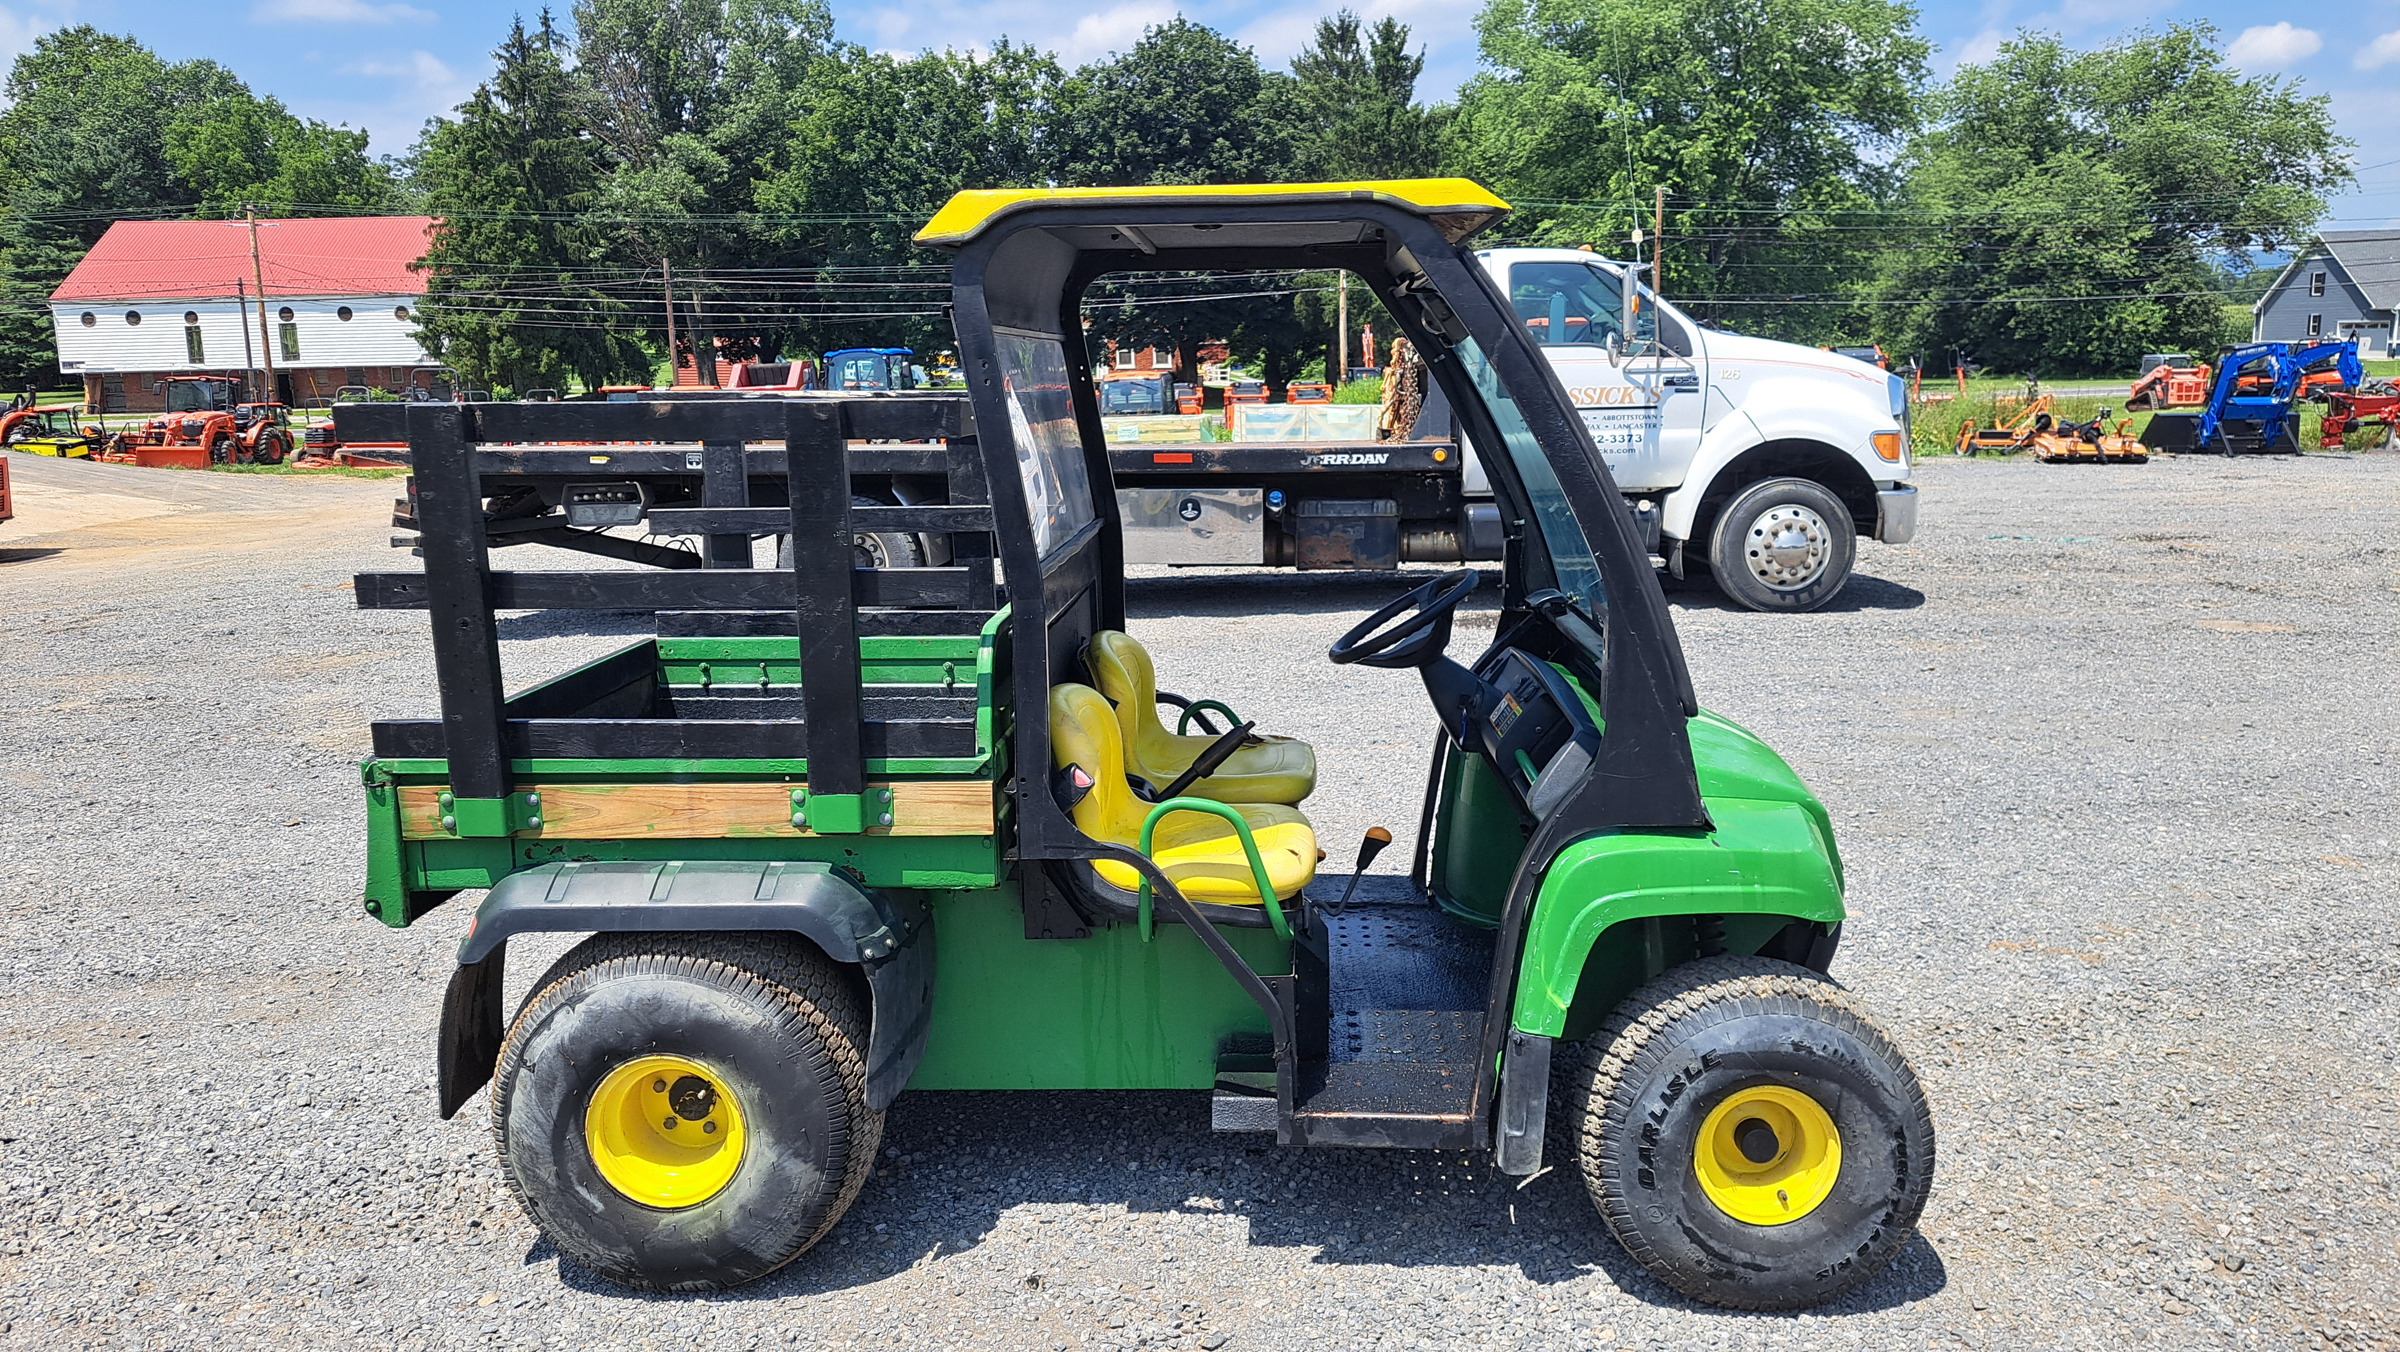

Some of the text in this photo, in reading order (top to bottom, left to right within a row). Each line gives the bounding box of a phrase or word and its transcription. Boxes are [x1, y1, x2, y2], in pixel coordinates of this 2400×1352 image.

[1719, 369, 1741, 380] 126
[1568, 386, 1663, 406] SSICK'S
[1591, 434, 1643, 444] 2-3373
[1599, 447, 1636, 455] cks.com
[723, 994, 755, 1016] TURF
[1637, 1048, 1722, 1191] CARLISLE
